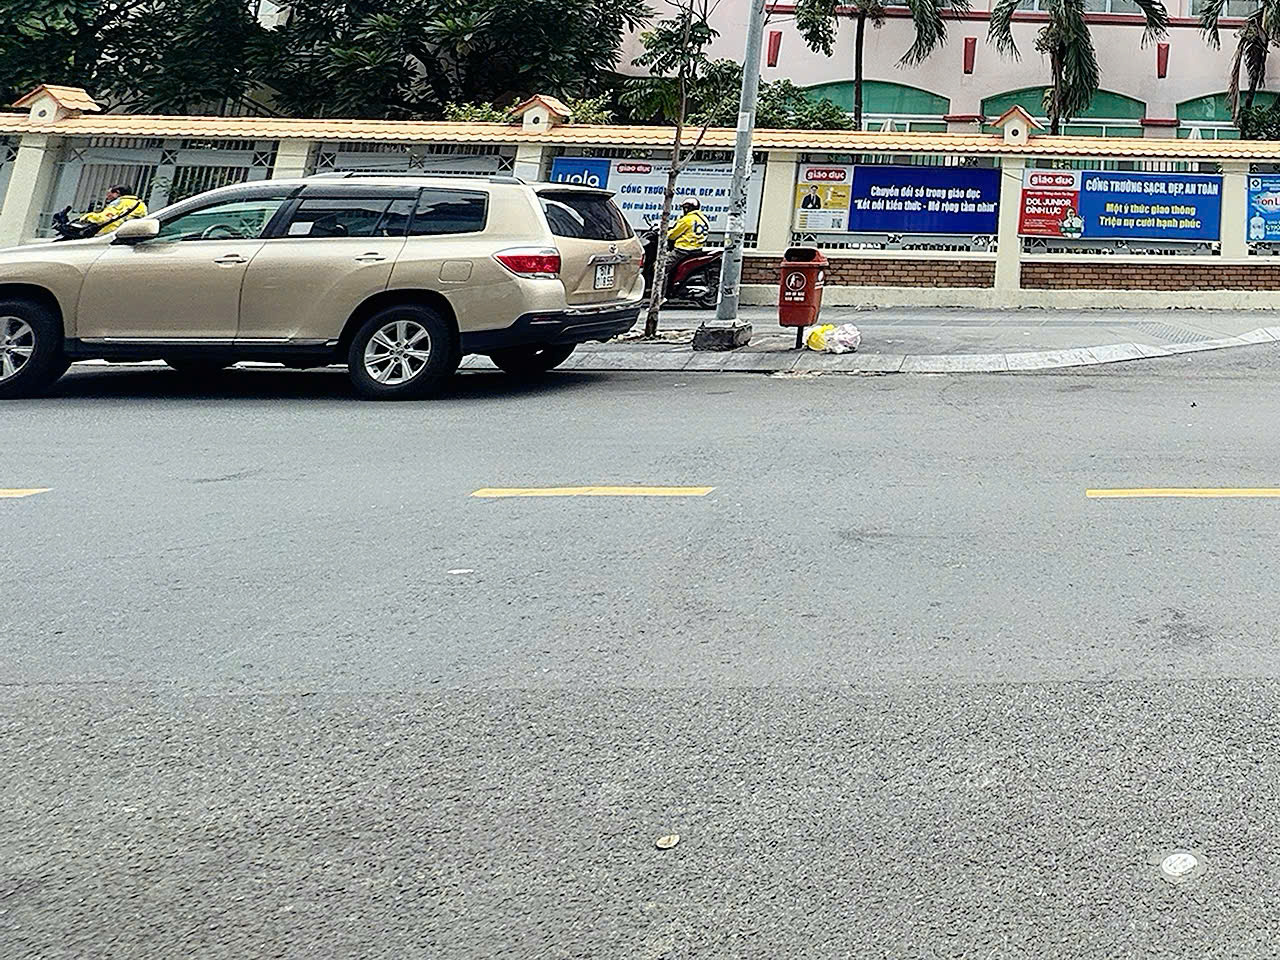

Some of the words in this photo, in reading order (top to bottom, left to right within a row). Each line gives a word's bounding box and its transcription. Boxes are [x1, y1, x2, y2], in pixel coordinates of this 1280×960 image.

[807, 170, 828, 180] giáo
[828, 170, 846, 180] dục
[1031, 174, 1053, 185] giáo
[1054, 176, 1073, 185] dục
[1085, 177, 1109, 191] CỔNG
[1109, 179, 1143, 193] TRƯỜNG
[1143, 182, 1167, 195] SẠCH,
[1185, 183, 1196, 194] AN
[1197, 182, 1219, 195] TOÀN
[715, 188, 726, 197] AN
[914, 186, 924, 197] số
[926, 188, 946, 199] trong
[948, 188, 964, 199] giáo
[966, 188, 981, 200] dục
[1026, 198, 1042, 206] DOL
[1043, 199, 1071, 207] JUNIOR
[1106, 203, 1123, 215] Một
[1130, 204, 1150, 214] thức
[1151, 205, 1170, 215] giao
[1171, 206, 1197, 216] thông
[1100, 216, 1122, 228] Triệu
[1123, 219, 1135, 229] nụ
[1156, 218, 1179, 230] hạnh
[1179, 219, 1202, 229] phúc
